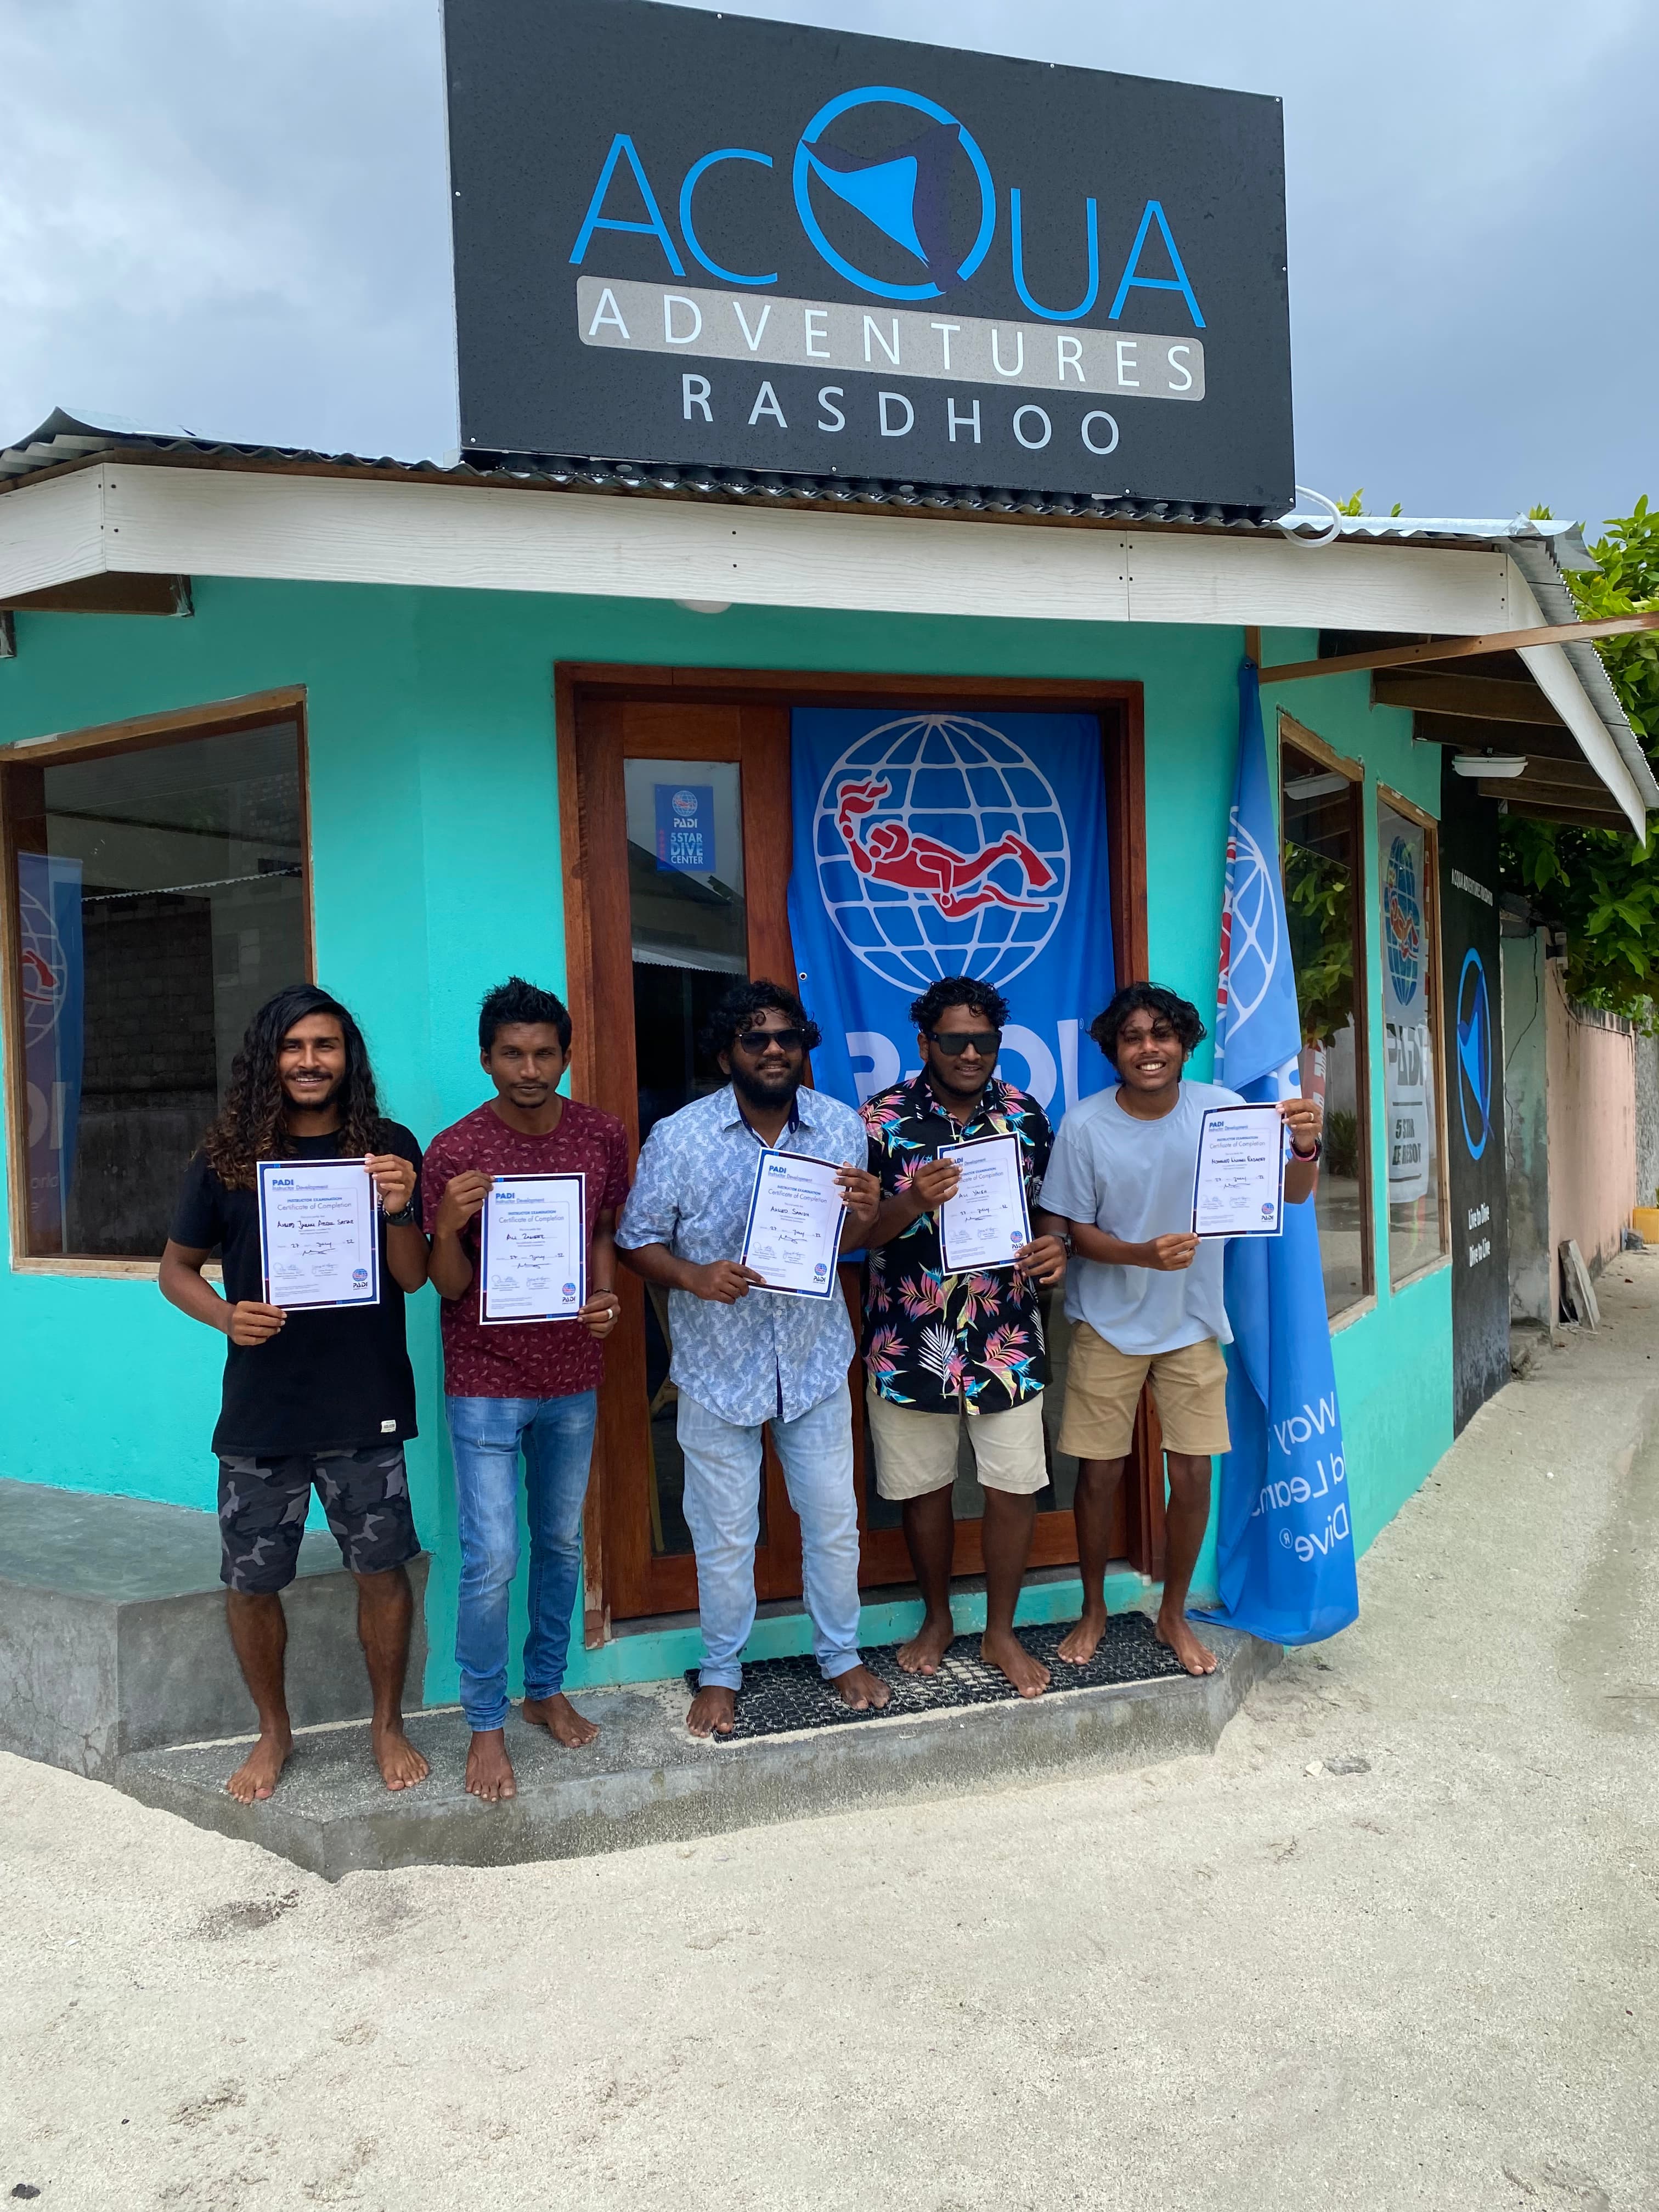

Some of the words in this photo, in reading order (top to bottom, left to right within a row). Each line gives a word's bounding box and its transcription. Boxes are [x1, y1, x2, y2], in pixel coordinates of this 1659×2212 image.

[569, 86, 1206, 328] ACQUA
[588, 287, 1194, 392] ADVENTURES
[683, 373, 1120, 455] RASDHOO
[674, 818, 698, 828] PADI
[670, 843, 703, 856] DIVE
[671, 856, 703, 865] CENTER
[769, 1165, 787, 1173] PADI
[768, 1188, 792, 1198] Certificate
[800, 1194, 827, 1204] Completion
[318, 1202, 352, 1210] Completion
